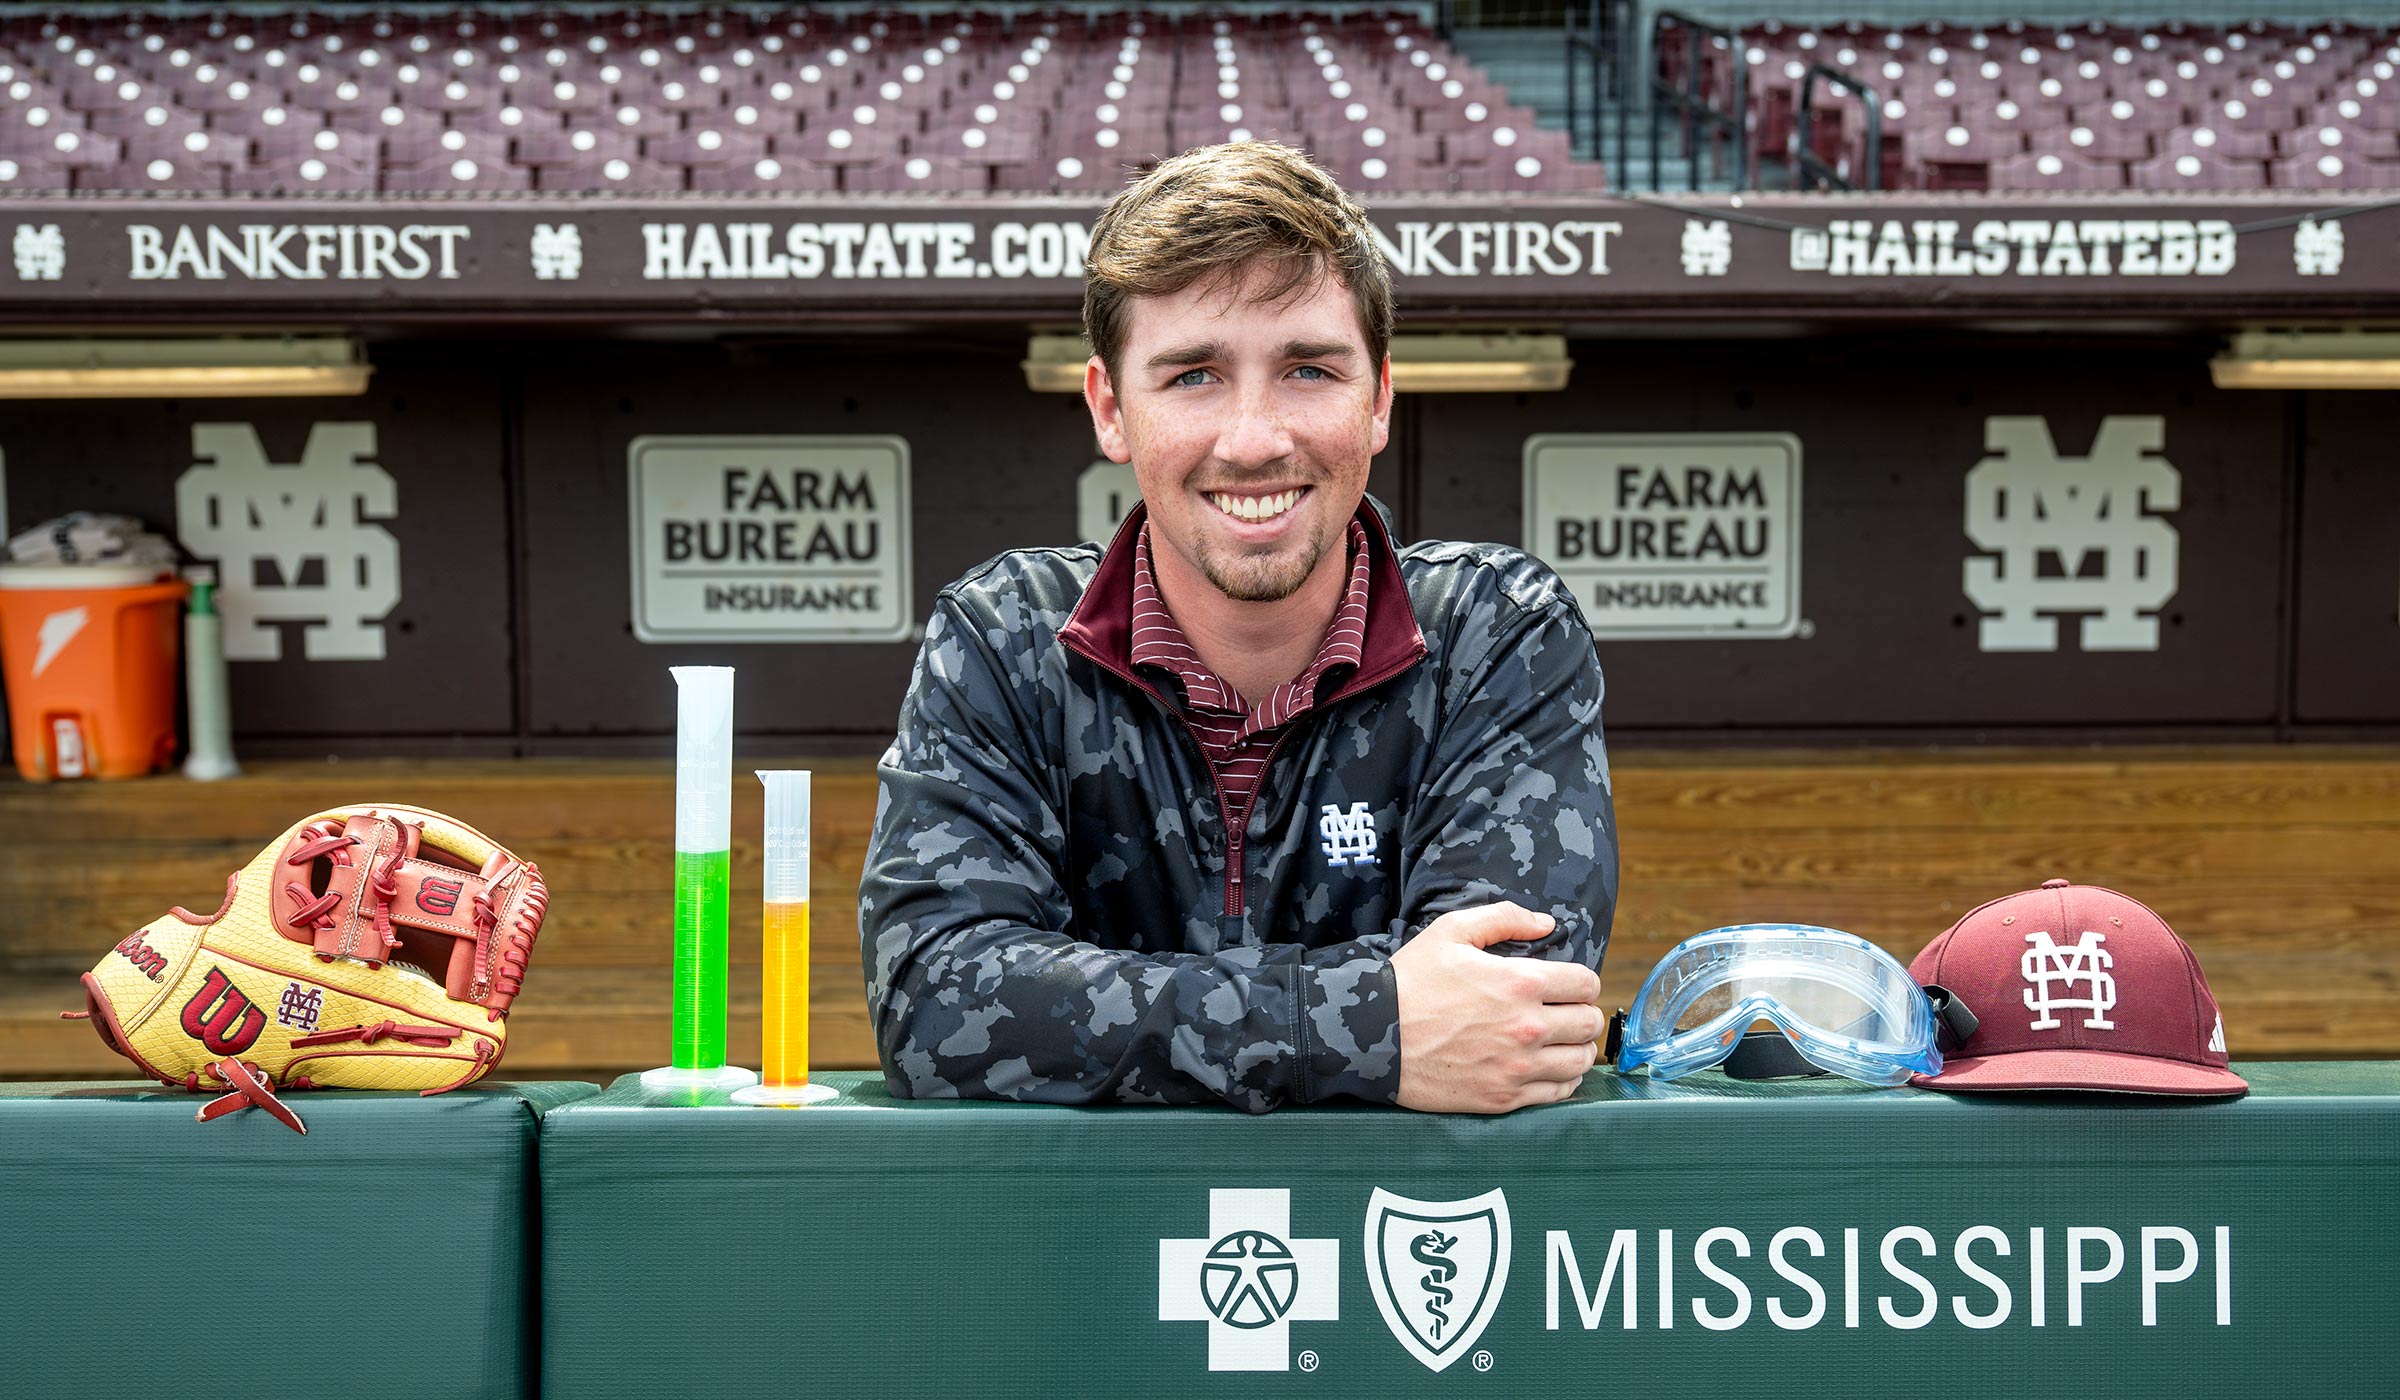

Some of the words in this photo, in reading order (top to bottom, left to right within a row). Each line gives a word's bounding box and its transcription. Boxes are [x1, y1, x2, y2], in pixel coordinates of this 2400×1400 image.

[128, 224, 471, 281] BANKFIRST
[1372, 221, 1623, 277] NKFIRST
[1790, 220, 2237, 277] @HAILSTATEBB
[723, 469, 877, 513] FARM
[1616, 466, 1767, 510] FARM
[664, 521, 879, 564] BUREAU
[1556, 517, 1770, 561] BUREAU
[705, 585, 879, 612] INSURANCE
[1595, 582, 1768, 609] INSURANCE
[1546, 1226, 2231, 1331] MISSISSIPPI
